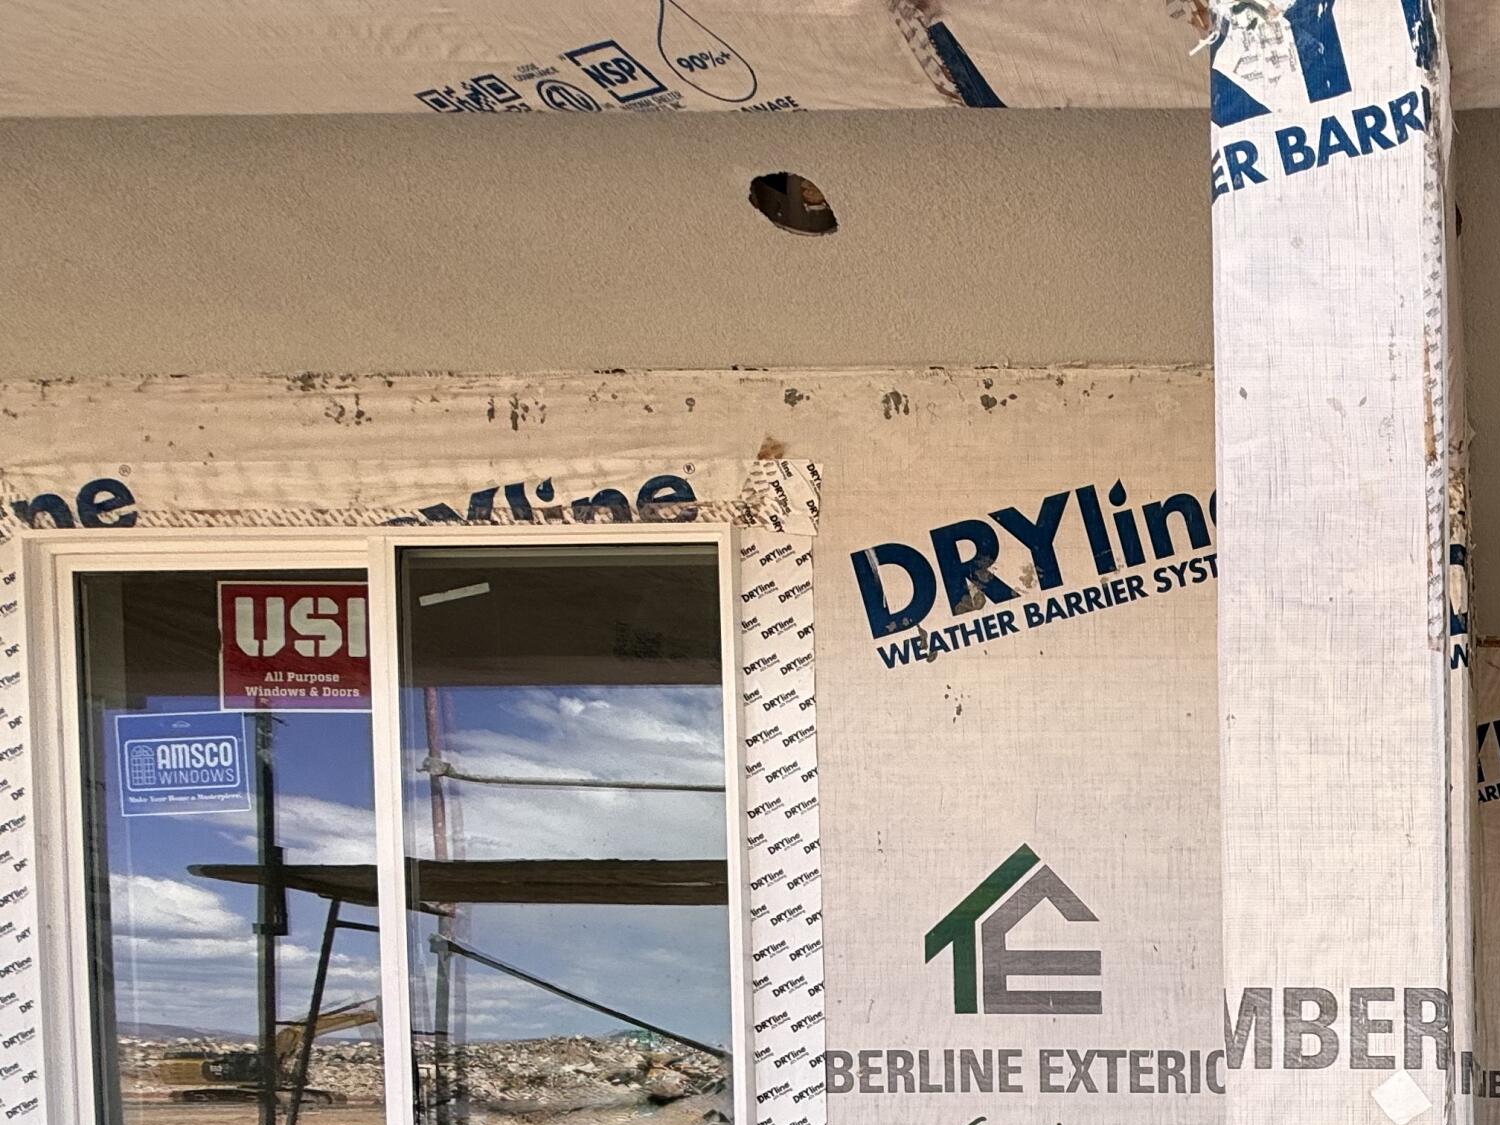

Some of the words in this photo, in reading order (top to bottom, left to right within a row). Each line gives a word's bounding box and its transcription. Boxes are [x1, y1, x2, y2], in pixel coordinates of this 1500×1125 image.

[581, 57, 637, 89] NSP
[850, 478, 1217, 639] DRYlin
[877, 610, 1019, 669] WEATHER
[1024, 575, 1148, 629] BARRIER
[245, 686, 306, 698] Windows
[310, 686, 318, 698] &
[322, 686, 360, 698] Doors
[264, 672, 284, 683] All
[287, 671, 340, 684] Purpose
[157, 742, 233, 769] AMSCO
[160, 768, 235, 785] WINDOWS
[827, 1049, 1025, 1093] BERLINE
